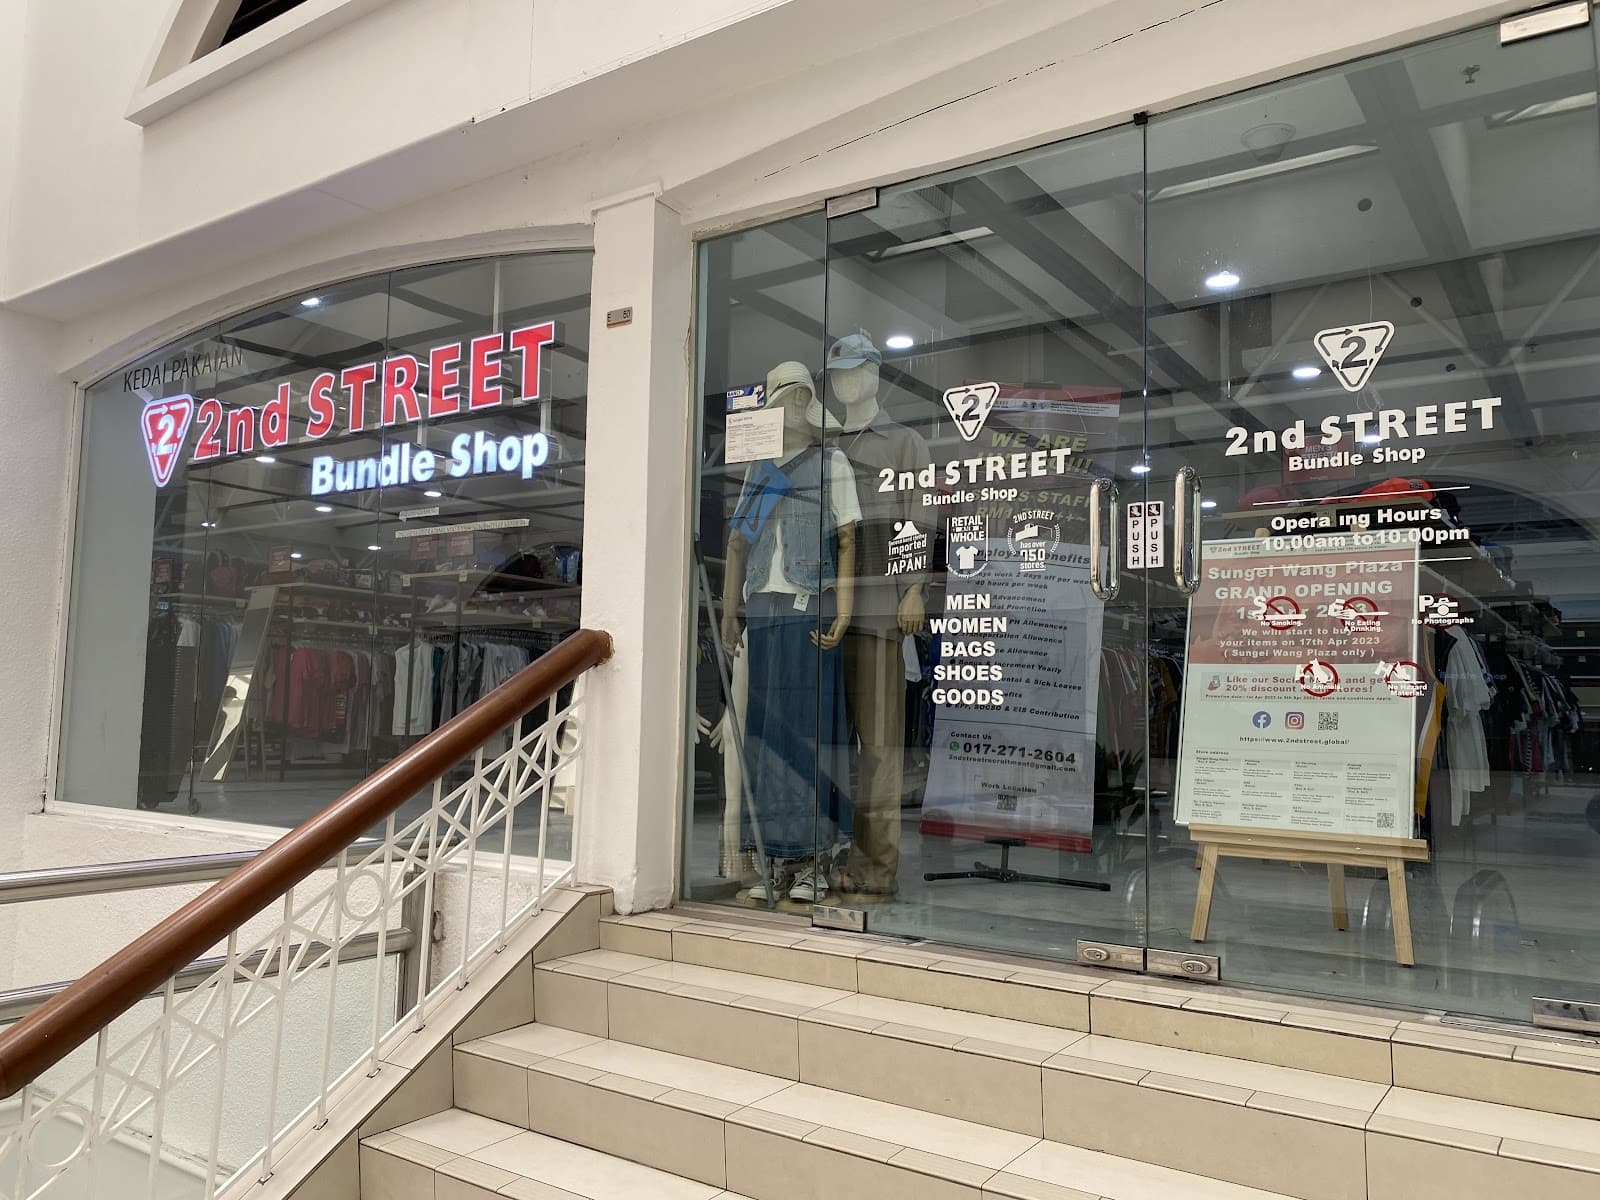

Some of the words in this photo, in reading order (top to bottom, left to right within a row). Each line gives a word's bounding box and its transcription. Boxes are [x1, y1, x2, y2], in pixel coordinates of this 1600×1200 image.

[1340, 335, 1367, 369] 2
[124, 363, 166, 392] KEDAI
[171, 345, 243, 383] PAKAIAN
[193, 382, 291, 461] 2nd
[306, 320, 556, 438] STREET
[961, 394, 980, 422] 2
[1225, 420, 1305, 456] 2nd
[1320, 397, 1502, 446] STREET
[992, 432, 1028, 448] WE
[1035, 434, 1089, 452] ARE
[310, 444, 436, 496] Bundle
[449, 430, 549, 479] Shop
[1289, 451, 1364, 471] Bundle
[1372, 447, 1426, 466] Shop
[878, 463, 936, 493] 2nd
[945, 447, 1072, 486] STREET
[922, 489, 975, 506] Bundle
[981, 487, 1018, 502] Shop
[951, 515, 983, 527] RETAIL
[1013, 512, 1027, 523] 2ND
[1028, 510, 1055, 520] STREET
[1378, 508, 1442, 523] Hours
[888, 533, 927, 556] Imported
[950, 531, 985, 543] WHOLE
[1020, 541, 1031, 549] has
[1132, 520, 1140, 566] PUSH
[1151, 518, 1159, 565] PUSH
[1262, 533, 1346, 552] 10.00am
[1353, 531, 1373, 546] to
[1375, 527, 1469, 548] 10.00pm
[1233, 544, 1260, 552] STREET
[885, 554, 927, 576] JAPAN!
[1208, 565, 1272, 583] Sungei
[1283, 563, 1337, 579] Wang
[1346, 560, 1403, 575] Plaza
[1023, 572, 1041, 581] days
[1216, 583, 1287, 600] GRAND
[1295, 580, 1393, 597] OPENING
[947, 594, 991, 610] MEN
[930, 617, 1007, 635] WOMEN
[1271, 620, 1304, 628] Smoking.
[1424, 617, 1475, 625] Photographs
[1241, 628, 1259, 636] We
[1262, 627, 1282, 635] will
[1285, 627, 1313, 635] start
[940, 641, 996, 657] BAGS
[1219, 639, 1244, 648] your
[1247, 638, 1278, 646] items
[1299, 638, 1323, 646] 17th
[1327, 637, 1348, 647] Apr
[1351, 636, 1381, 645] 2023
[1231, 649, 1269, 659] Sungei
[1272, 648, 1303, 659] Wang
[1306, 648, 1338, 658] Plaza
[1342, 648, 1367, 658] only
[933, 665, 1003, 681] SHOES
[1037, 664, 1062, 674] Yearly
[1034, 679, 1051, 687] Sick
[1226, 675, 1248, 683] Like
[1346, 676, 1366, 684] and
[1226, 684, 1247, 692] 20%
[1251, 684, 1296, 692] discount
[932, 689, 1004, 705] GOODS
[1030, 707, 1080, 720] Contribution
[951, 731, 979, 739] Contact
[963, 742, 1076, 764] 017-271-2604
[981, 782, 1000, 790] Work
